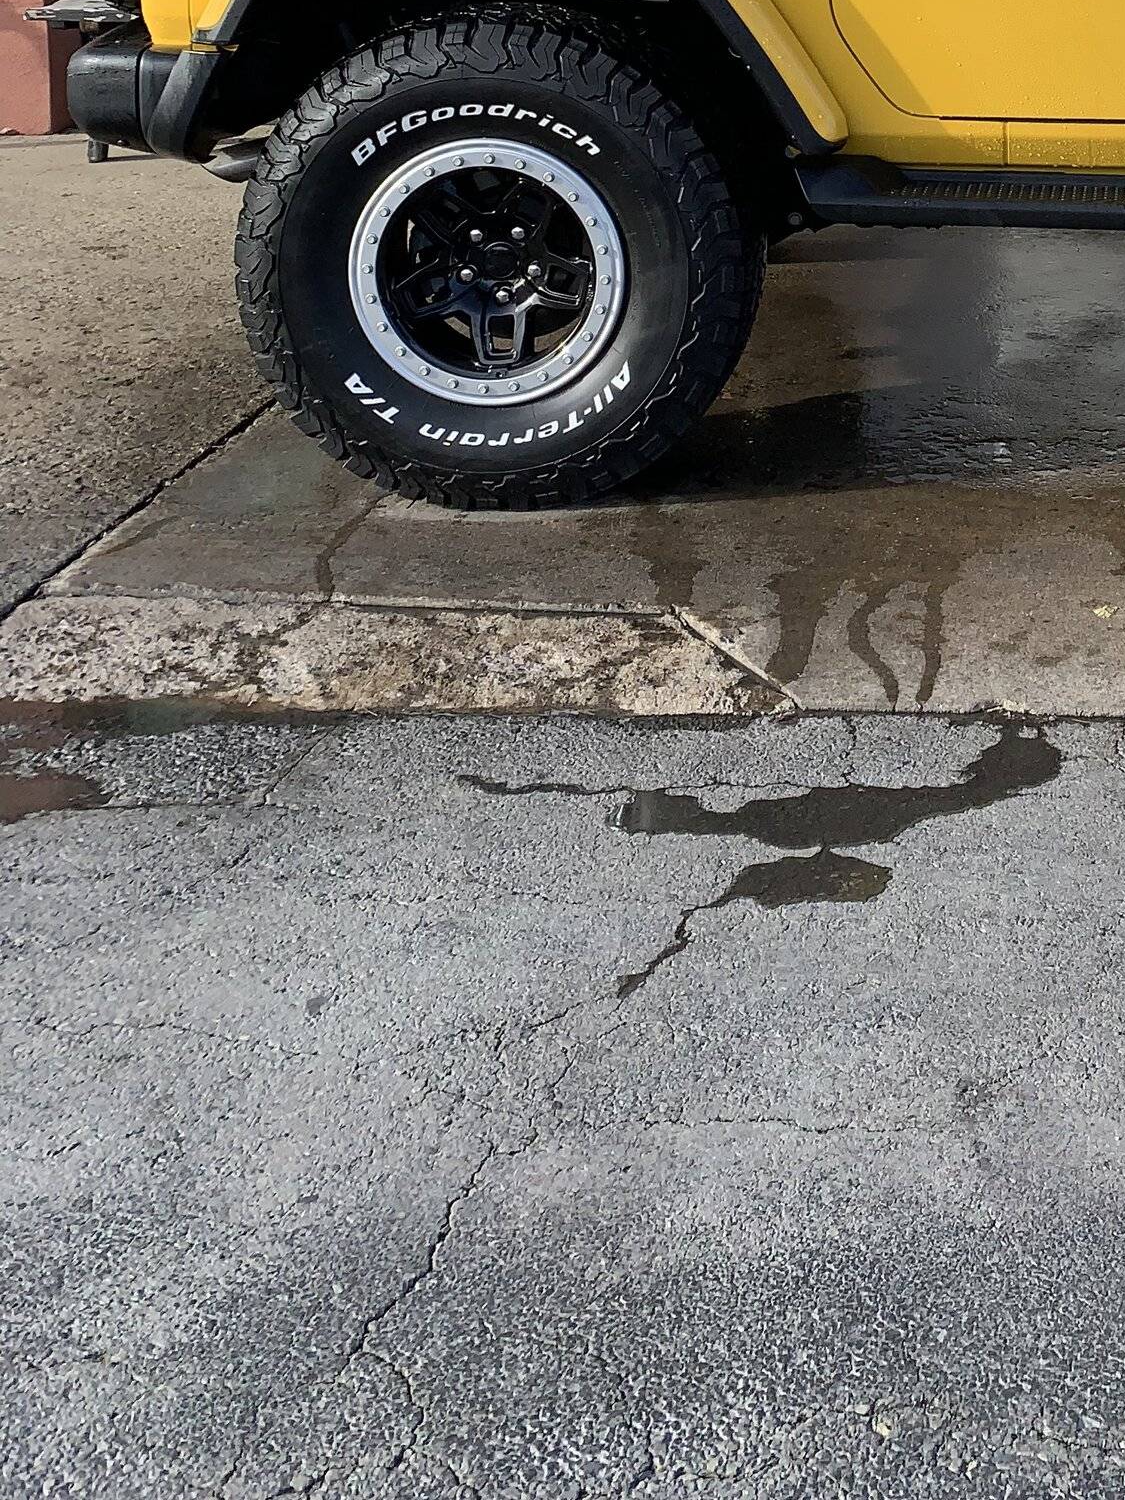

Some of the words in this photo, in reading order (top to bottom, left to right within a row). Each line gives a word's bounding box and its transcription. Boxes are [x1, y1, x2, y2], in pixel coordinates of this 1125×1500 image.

[350, 103, 601, 167] BFGoodrich
[343, 371, 401, 425] T/A
[418, 358, 632, 448] All-Terrain
